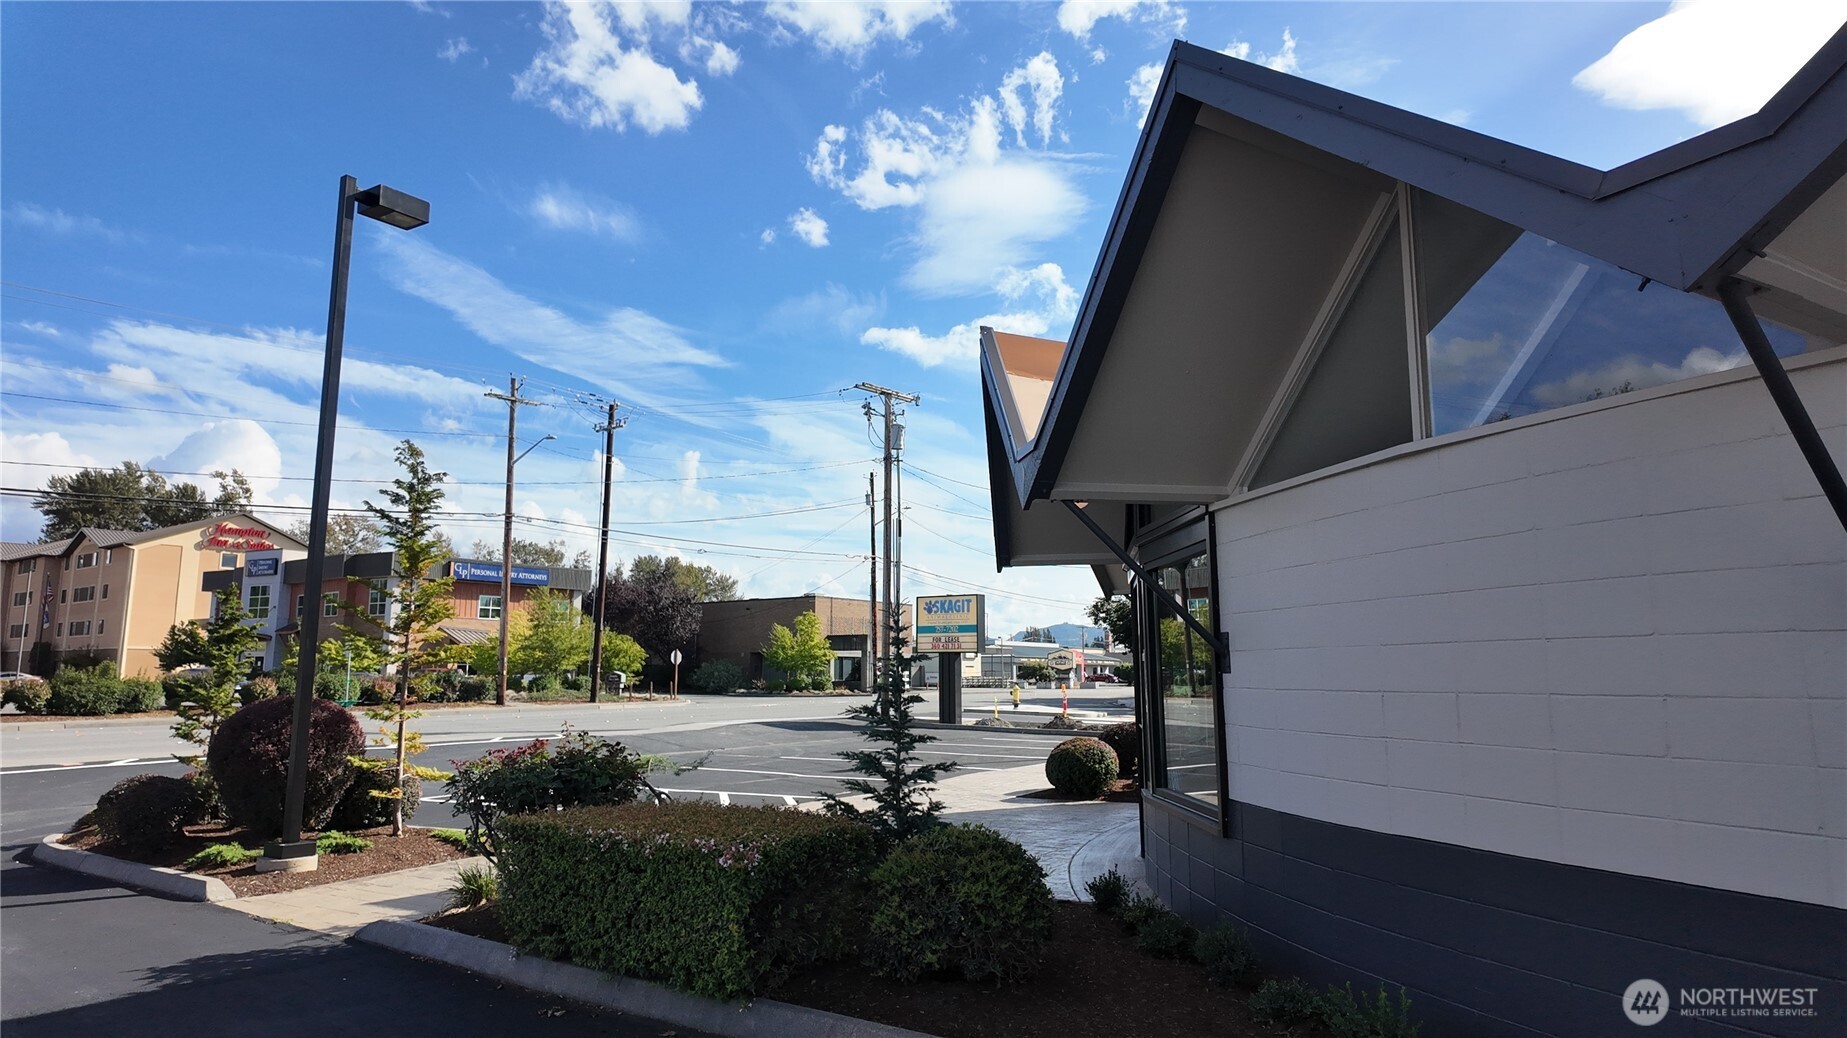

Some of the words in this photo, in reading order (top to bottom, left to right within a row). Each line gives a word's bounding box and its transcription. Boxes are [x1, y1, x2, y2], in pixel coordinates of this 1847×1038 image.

[206, 523, 271, 538] Hampton
[471, 568, 498, 577] PERSONAL
[518, 572, 548, 581] ATTORNEYS
[933, 599, 972, 613] SKAGIT
